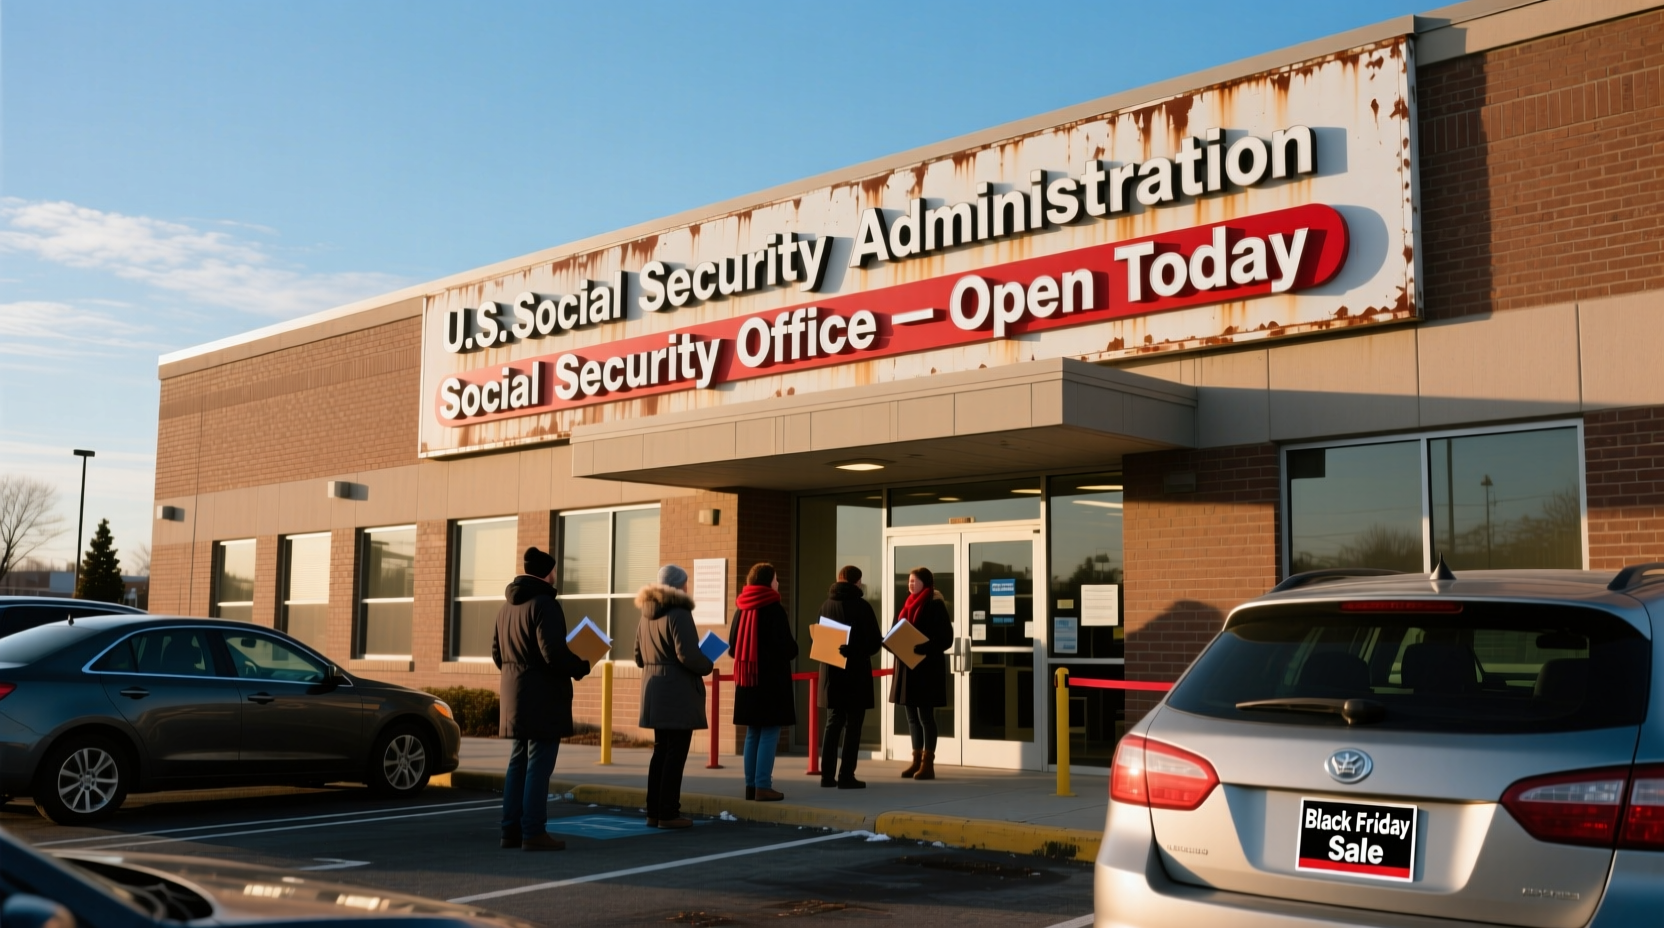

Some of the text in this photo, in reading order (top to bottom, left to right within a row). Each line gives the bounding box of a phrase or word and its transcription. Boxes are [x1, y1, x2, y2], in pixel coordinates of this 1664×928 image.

[443, 125, 1317, 354] U.S. Social Security Administration
[440, 361, 543, 420] Social
[554, 334, 721, 399] Security
[736, 307, 878, 367] Office
[949, 268, 1095, 338] Open
[1113, 226, 1310, 302] Today
[1304, 808, 1410, 840] Black Friday
[1328, 834, 1384, 864] Sale
